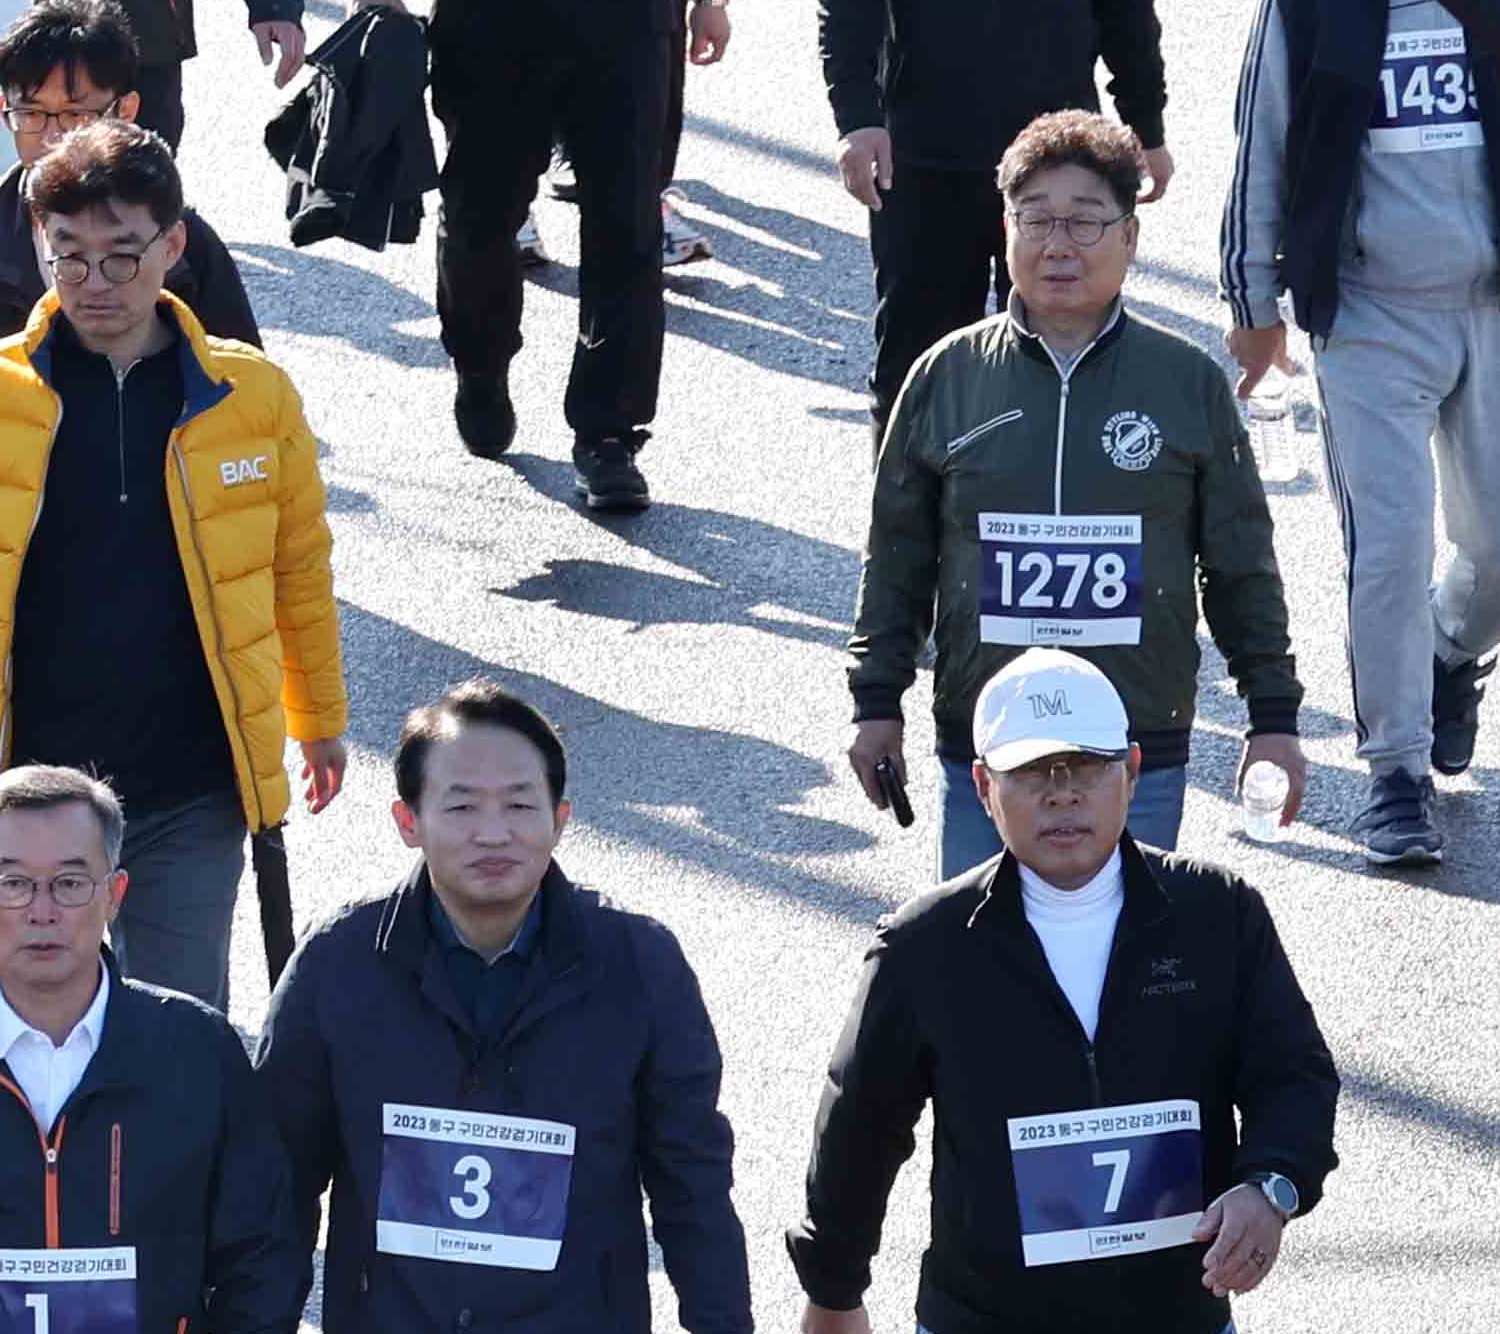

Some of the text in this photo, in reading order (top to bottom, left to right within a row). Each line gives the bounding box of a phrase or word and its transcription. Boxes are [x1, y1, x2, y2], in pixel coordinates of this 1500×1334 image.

[219, 455, 268, 485] BAC
[986, 521, 1016, 535] 2023
[995, 550, 1128, 609] 1278
[392, 1114, 427, 1131] 2023
[1018, 1125, 1057, 1142] 2023
[450, 1154, 493, 1220] 3
[1092, 1149, 1131, 1214] 7
